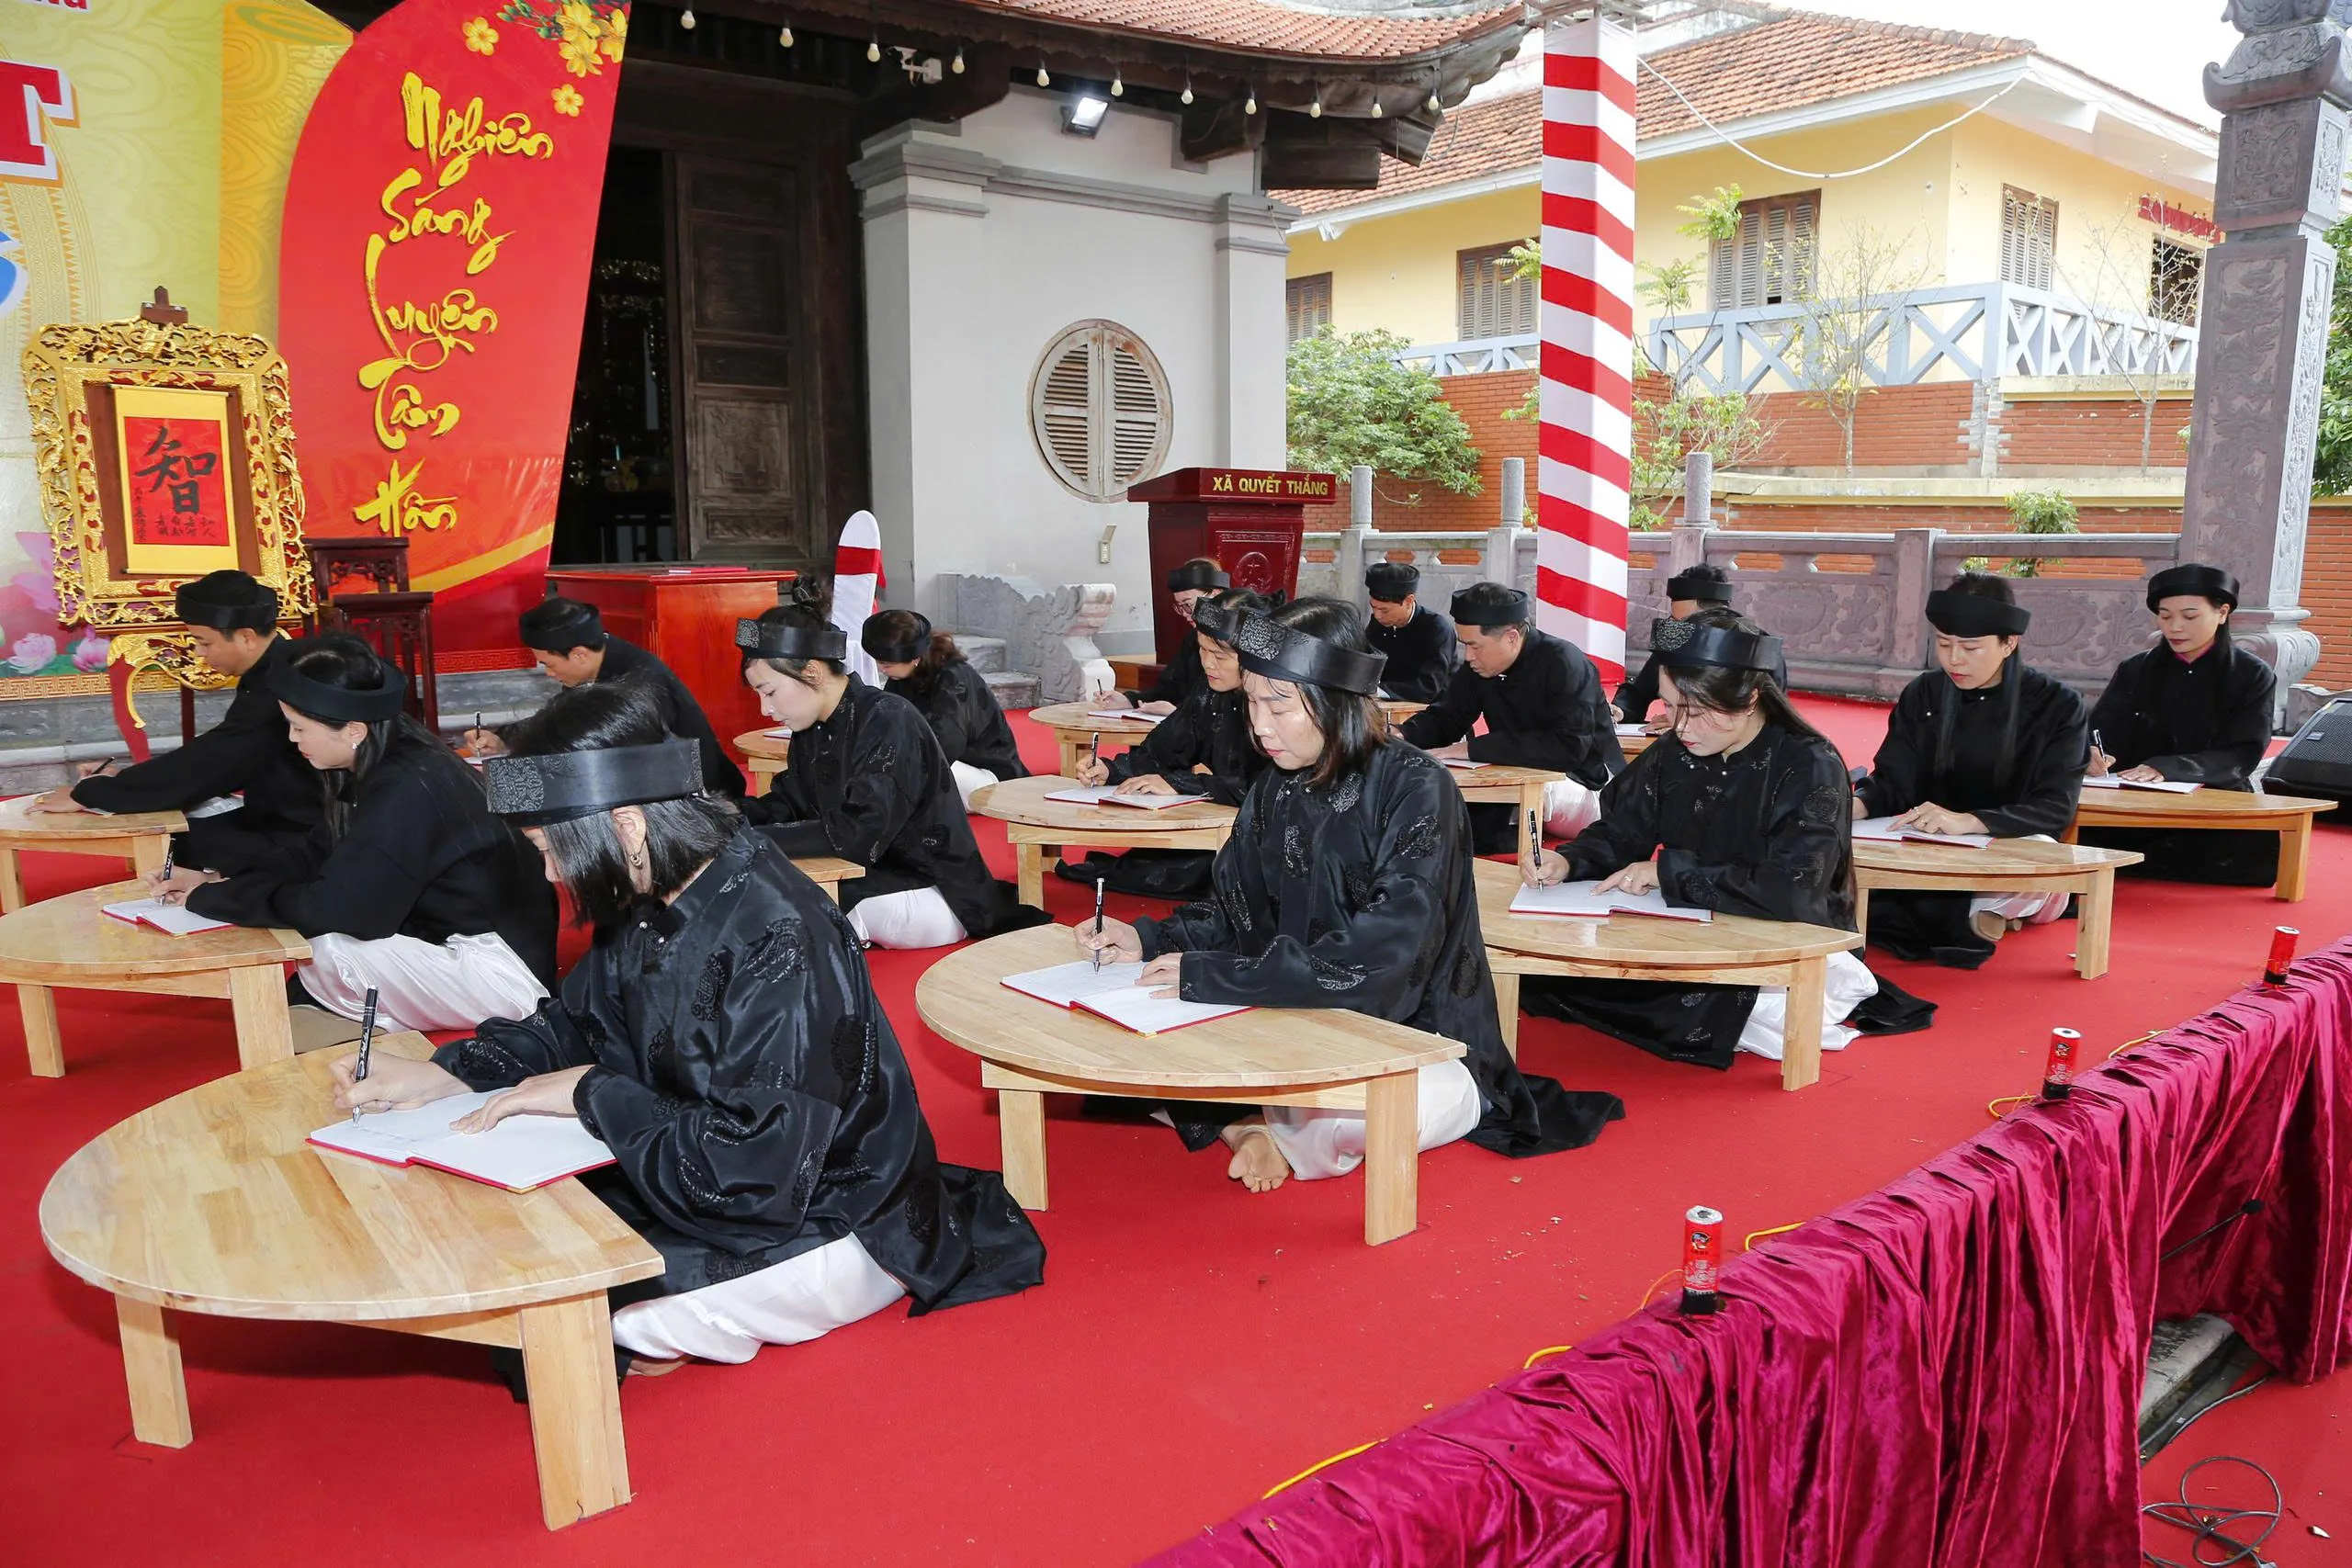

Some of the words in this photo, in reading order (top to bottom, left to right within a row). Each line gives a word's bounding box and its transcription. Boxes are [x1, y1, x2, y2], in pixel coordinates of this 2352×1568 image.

[401, 71, 554, 186] Nghiên
[381, 167, 515, 275] Sáng
[365, 234, 498, 370] Luyện
[357, 356, 460, 450] Tâm
[135, 425, 217, 513] 智
[353, 458, 458, 538] Hồn
[1213, 474, 1233, 491] XÃ
[1238, 474, 1281, 493] QUYẾT
[1286, 475, 1328, 495] THẮNG
